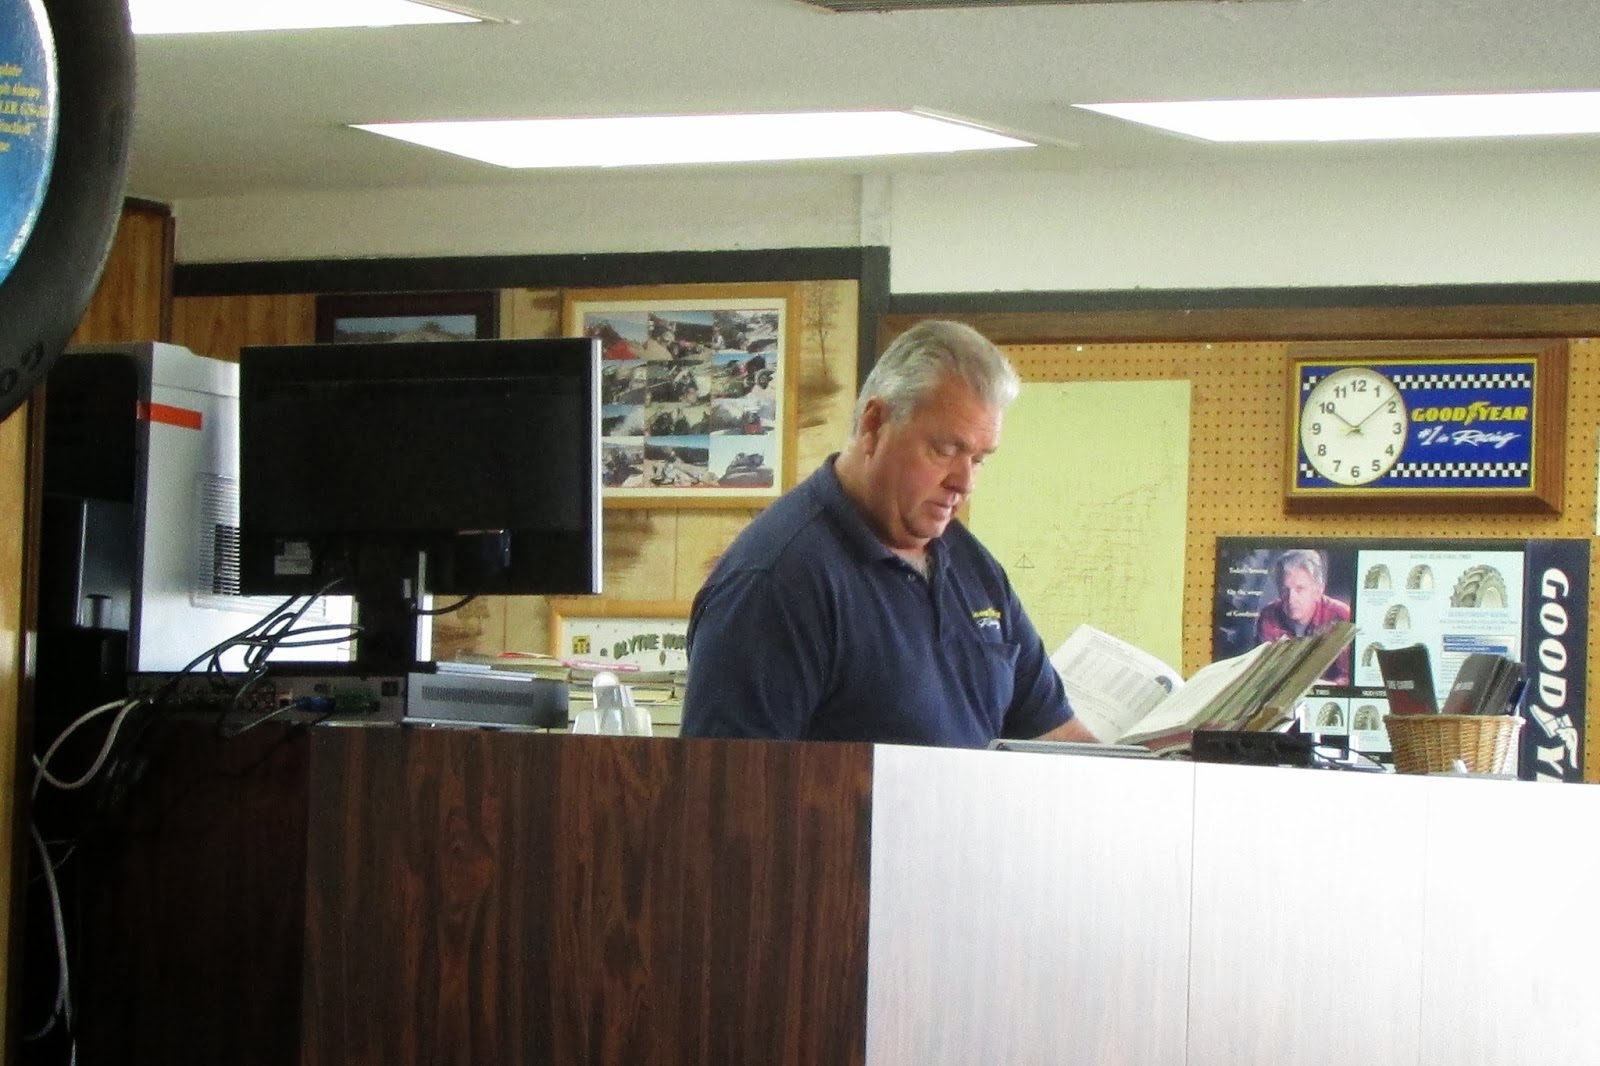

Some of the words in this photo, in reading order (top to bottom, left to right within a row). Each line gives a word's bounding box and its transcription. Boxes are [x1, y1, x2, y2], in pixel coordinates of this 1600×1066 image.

[1333, 386, 1347, 398] 11
[1351, 380, 1367, 392] 12
[1374, 385, 1381, 398] 1
[1319, 402, 1335, 414] 10
[1388, 401, 1397, 414] 2
[1411, 401, 1529, 426] GOODYEAR
[1312, 423, 1322, 435] 9
[1393, 422, 1402, 435] 3
[1417, 425, 1444, 446] #1
[1451, 429, 1522, 449] Racing
[1317, 444, 1327, 457] 8
[1385, 444, 1395, 457] 4
[1333, 460, 1342, 472] 7
[1351, 465, 1360, 478] 6
[1371, 460, 1381, 472] 5
[1536, 567, 1569, 783] GOODY
